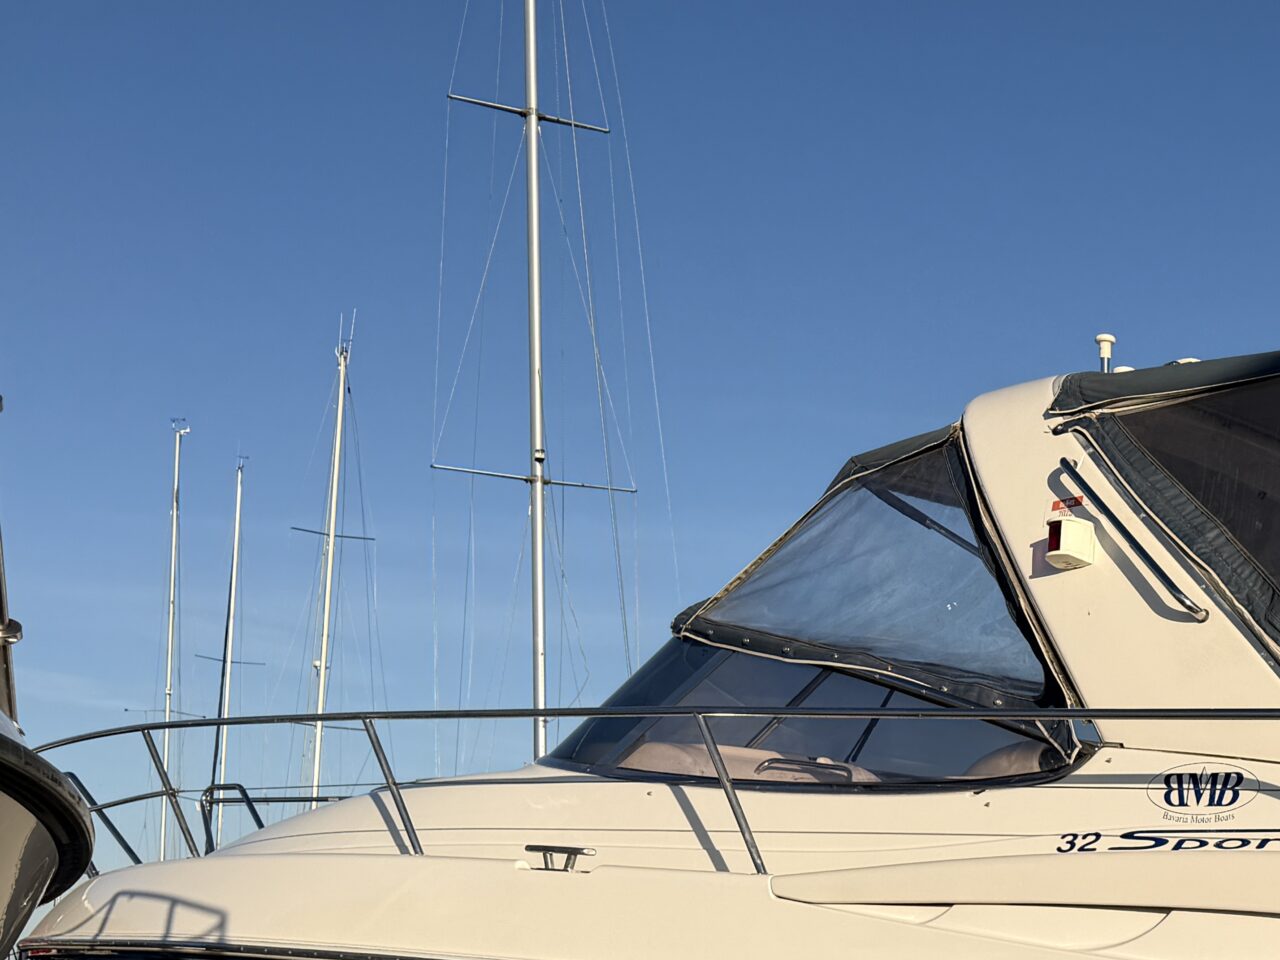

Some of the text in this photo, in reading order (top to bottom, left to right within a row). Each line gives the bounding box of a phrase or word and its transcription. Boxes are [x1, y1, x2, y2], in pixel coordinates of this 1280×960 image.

[1162, 811, 1236, 824] Bavaria Motor Boats
[1056, 832, 1101, 852] 32
